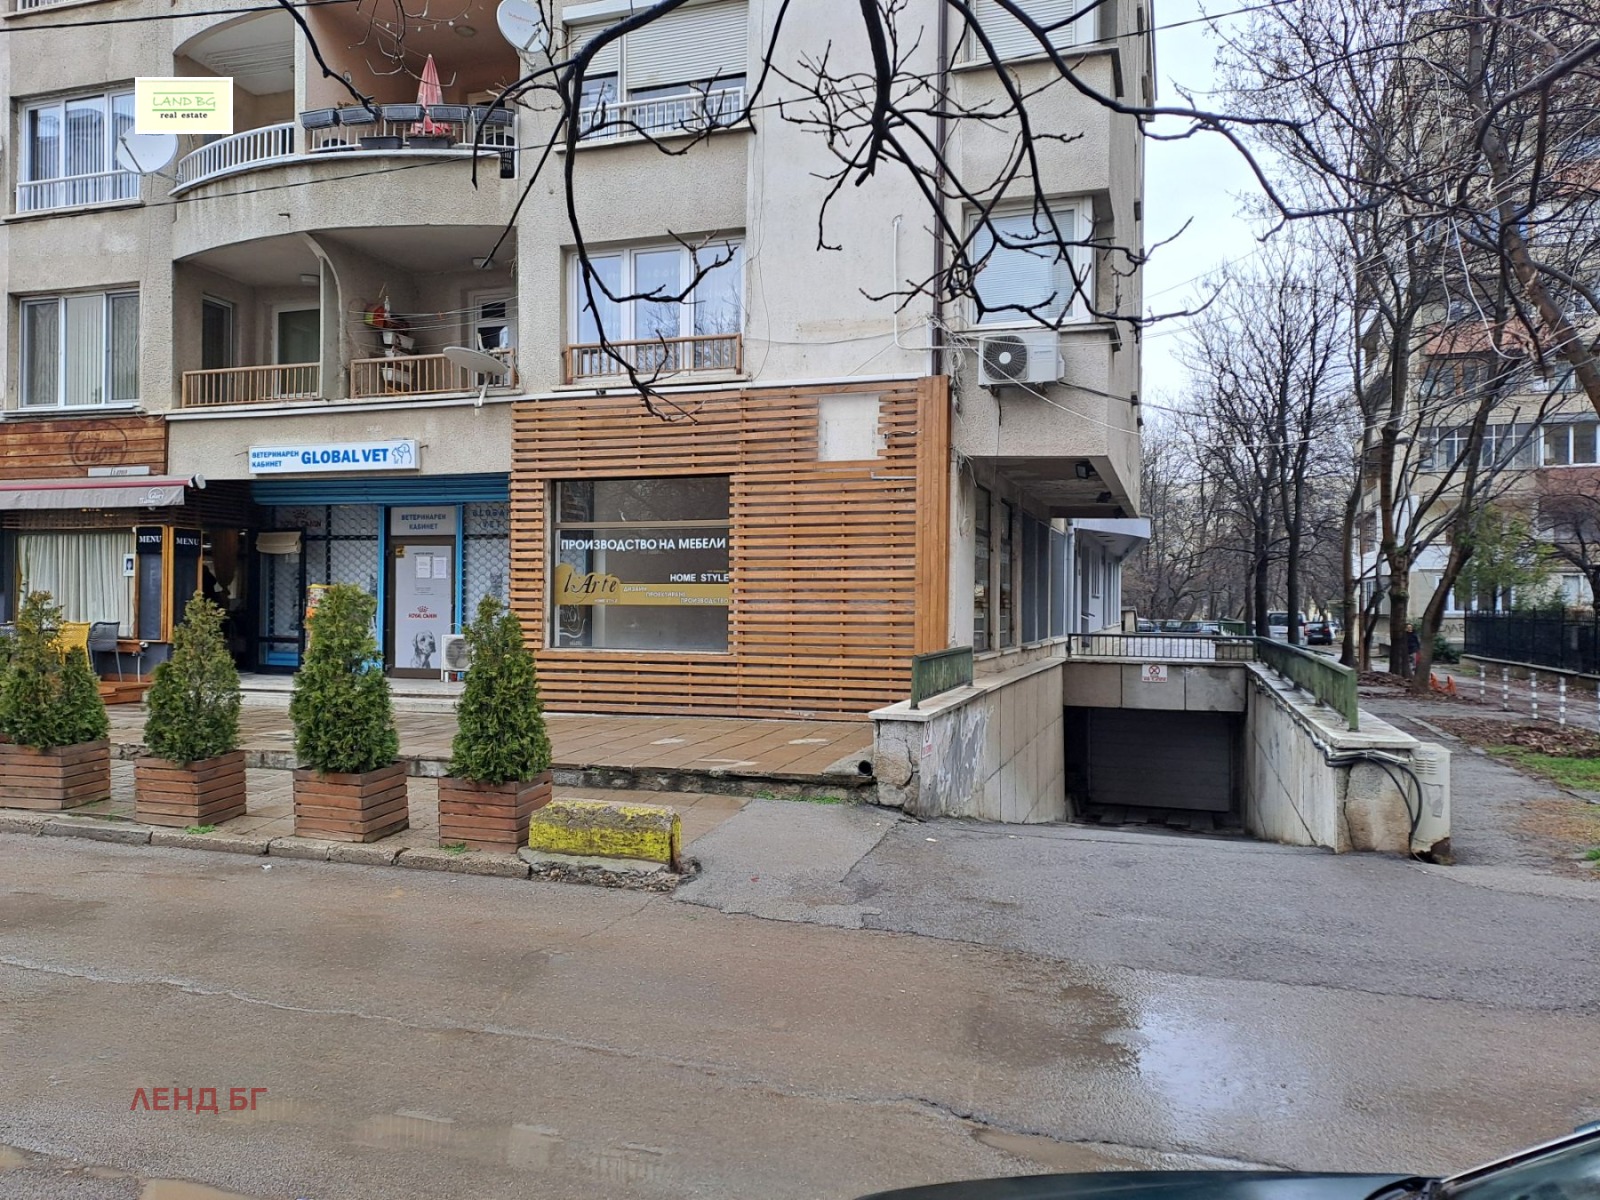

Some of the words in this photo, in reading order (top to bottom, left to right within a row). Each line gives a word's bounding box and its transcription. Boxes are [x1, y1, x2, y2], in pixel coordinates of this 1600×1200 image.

[301, 449, 360, 464] GLOBAL
[362, 449, 389, 462] VET
[252, 460, 282, 468] КАБИНЕТ
[139, 535, 162, 543] MENU
[176, 537, 199, 546] MENU
[560, 539, 657, 552] ПРОИЗВОДСТВО
[659, 539, 675, 550] НА
[678, 537, 726, 550] МЕБЕЛИ
[670, 573, 697, 582] HOME
[700, 573, 729, 582] STYLE
